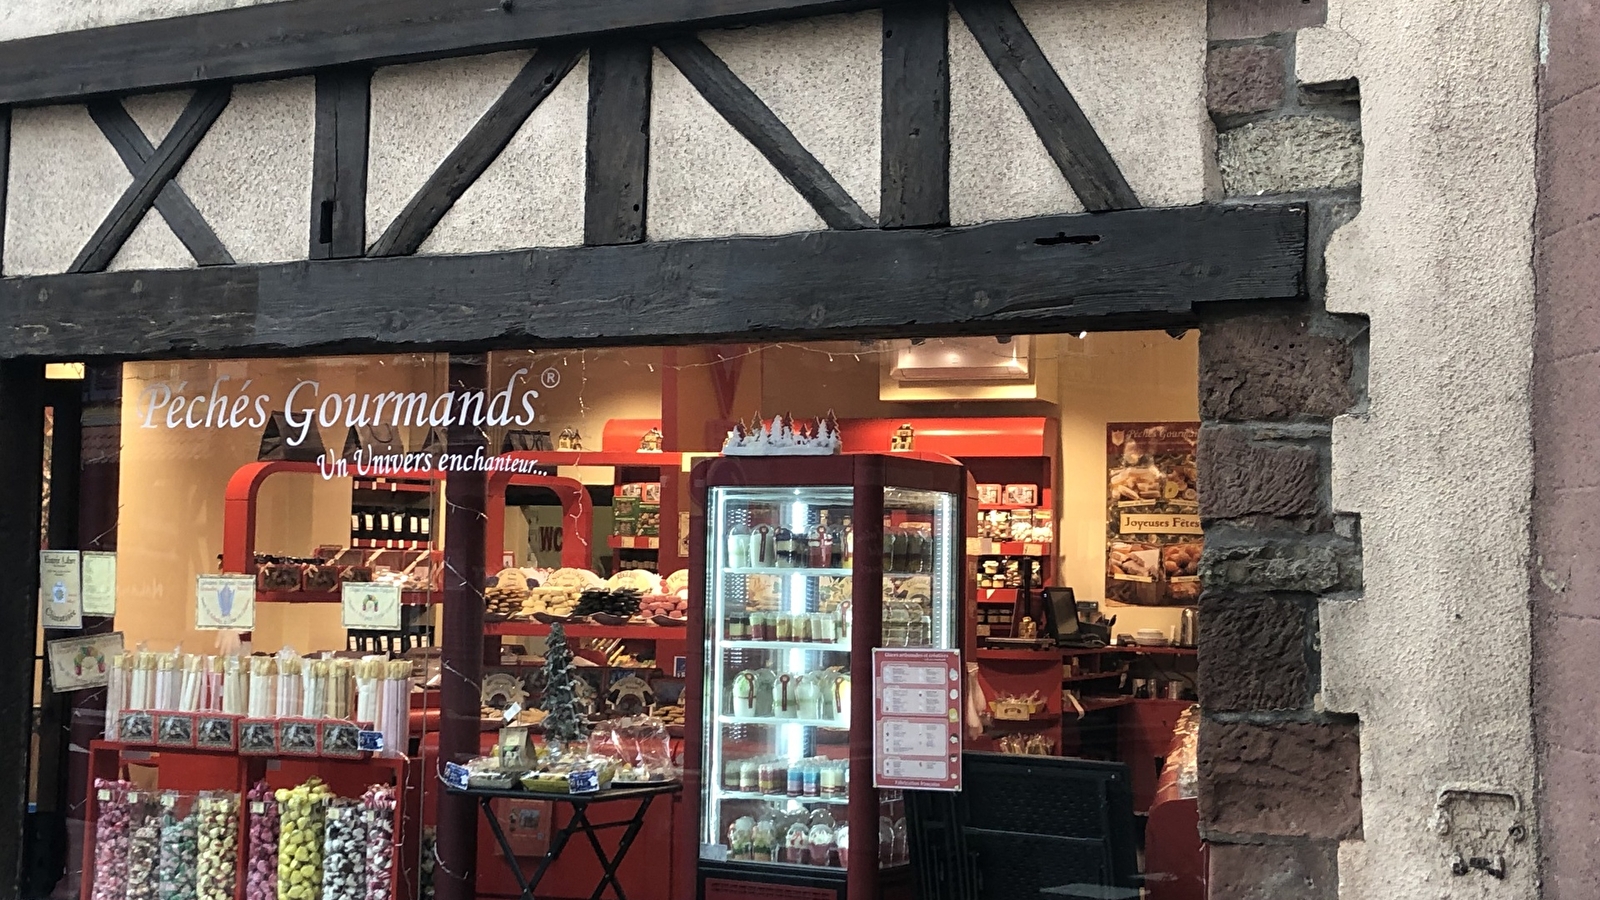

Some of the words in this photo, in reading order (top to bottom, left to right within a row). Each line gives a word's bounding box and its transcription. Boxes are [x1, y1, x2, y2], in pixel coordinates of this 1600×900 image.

[136, 375, 270, 429] Péchés
[284, 367, 539, 446] Gourmands
[316, 448, 349, 481] Un
[353, 443, 433, 477] Univers
[438, 445, 548, 477] enchanteur...
[539, 526, 564, 552] WC
[1124, 516, 1170, 530] Joyeuses
[1172, 517, 1200, 528] Fêtes
